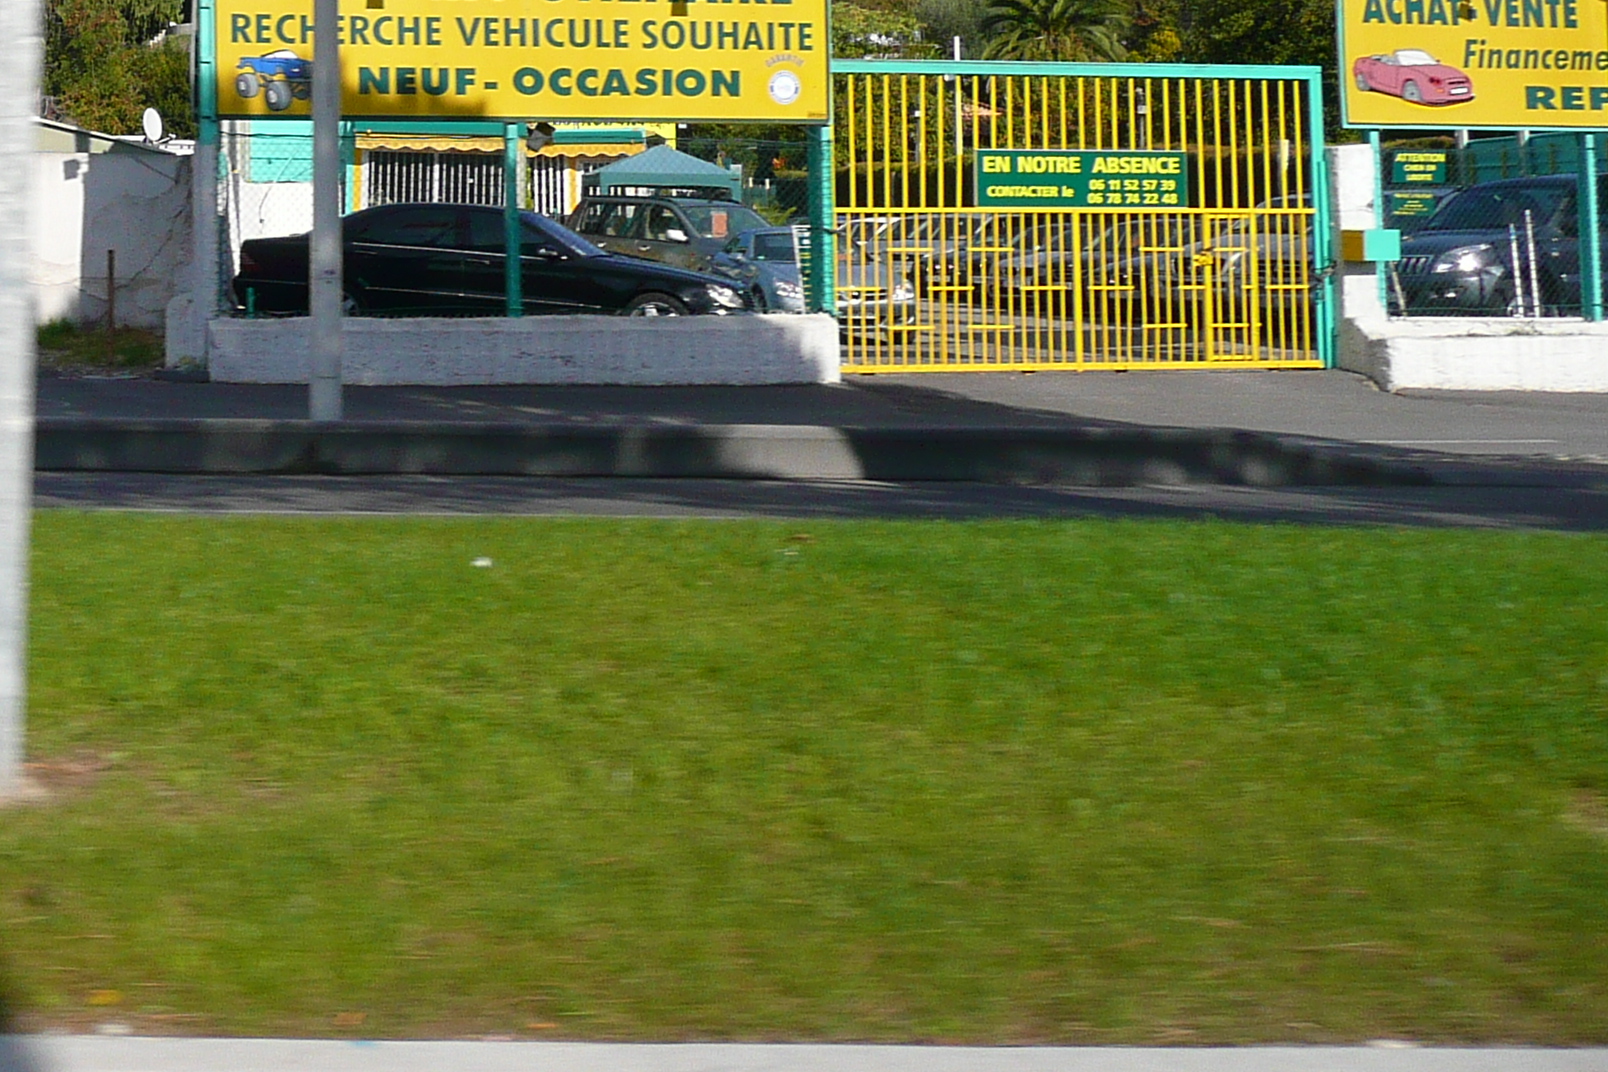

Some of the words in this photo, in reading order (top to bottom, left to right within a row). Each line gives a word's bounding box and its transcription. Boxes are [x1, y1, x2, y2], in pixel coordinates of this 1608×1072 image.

[456, 16, 629, 48] VEHICULE
[642, 20, 813, 51] SOUHAITE
[513, 67, 741, 97] OCCASION
[982, 156, 1010, 173] EN
[1017, 156, 1081, 173] NOTRE
[1092, 157, 1181, 174] ABSENCE
[987, 186, 1059, 198] CONTACTER
